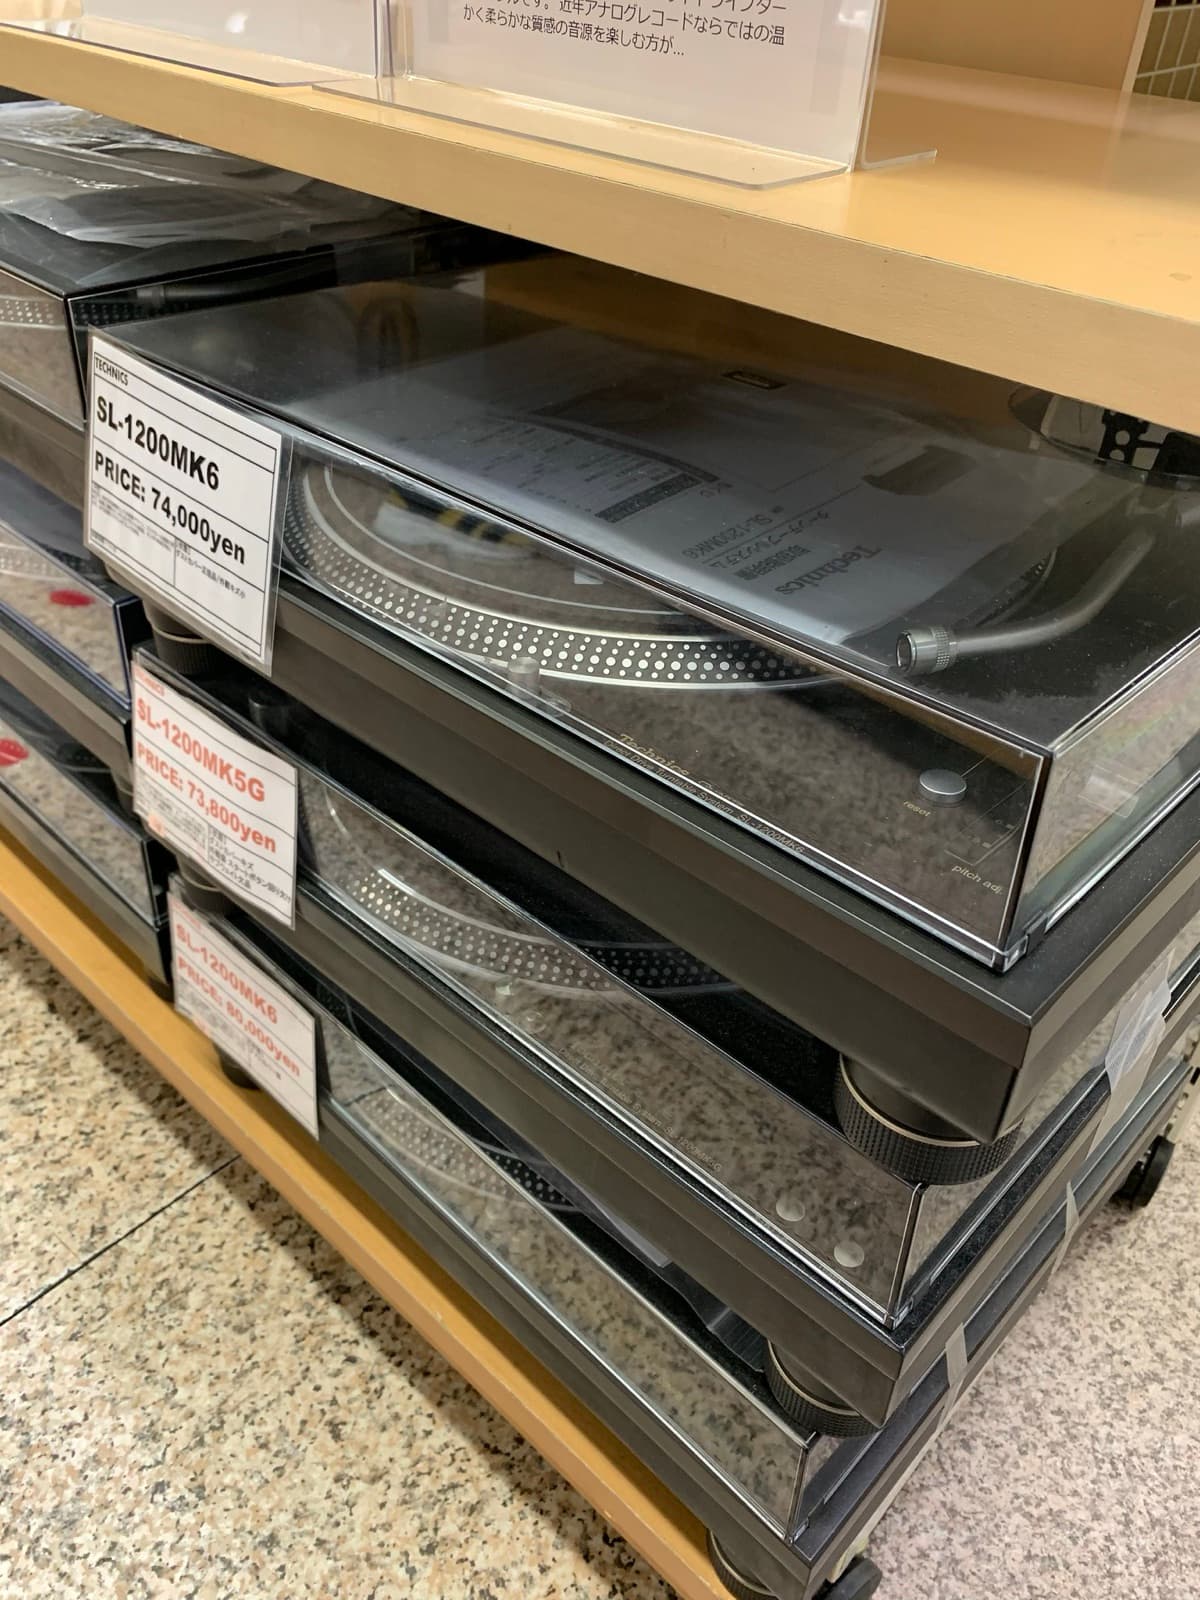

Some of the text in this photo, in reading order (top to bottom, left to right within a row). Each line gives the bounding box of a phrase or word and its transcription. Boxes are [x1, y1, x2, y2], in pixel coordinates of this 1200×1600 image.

[95, 357, 129, 386] TECHNICS
[97, 395, 220, 491] SL-1200MK6
[95, 450, 146, 502] PRICE:
[151, 487, 246, 565] 74,000yen
[775, 545, 885, 595] Technics
[137, 697, 265, 802] SL-1200MK5G
[137, 741, 184, 792] PRICE:
[187, 780, 277, 854] 73,800yen
[903, 800, 932, 818] reset
[951, 864, 982, 883] pitch
[176, 923, 278, 1025] SL-1200MK6
[178, 955, 223, 1007] PRICE:
